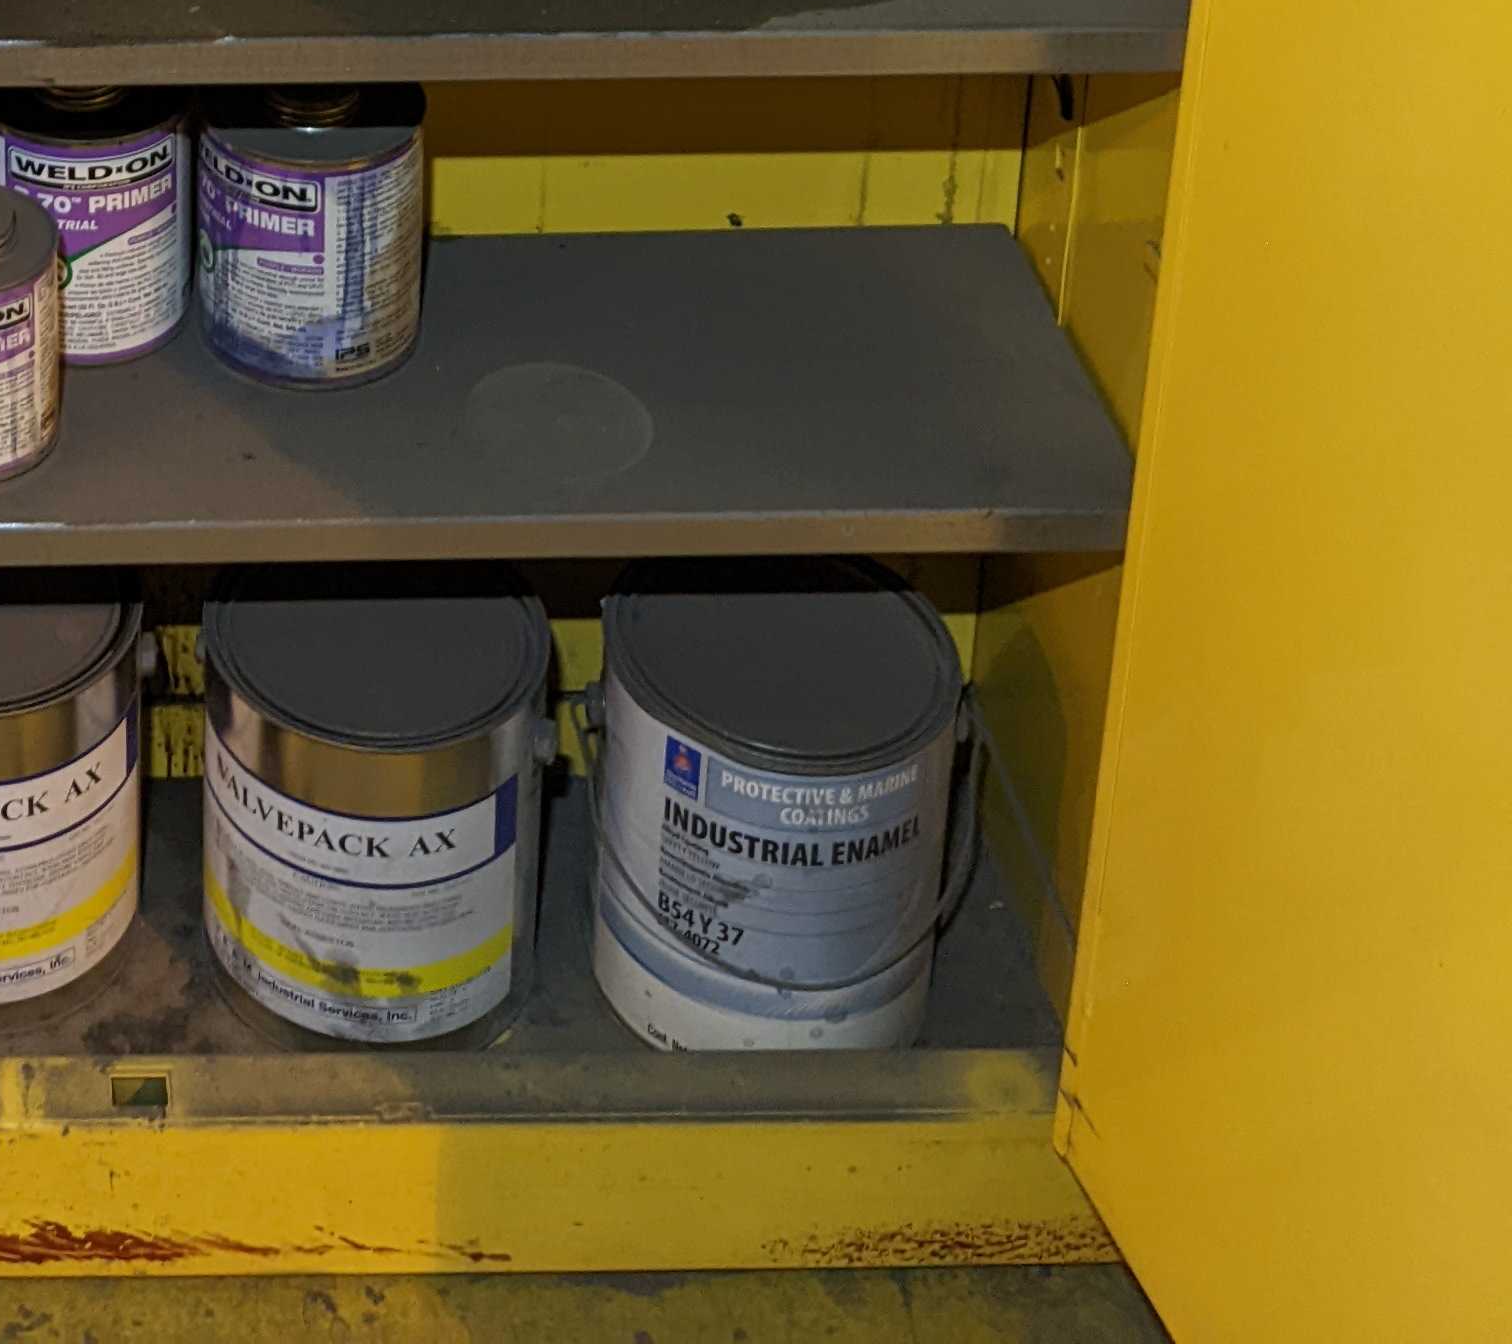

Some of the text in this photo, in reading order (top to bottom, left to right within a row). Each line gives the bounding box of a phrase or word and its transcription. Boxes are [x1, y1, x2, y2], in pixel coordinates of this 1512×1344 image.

[88, 173, 173, 213] PRIMER
[64, 760, 104, 804] AX
[720, 764, 919, 806] PROTECTIVE & MARINE
[216, 752, 457, 859] VALVEPACK AX
[779, 805, 870, 827] COATINGS
[663, 796, 920, 867] INDUSTRIAL ENAMEL
[257, 969, 316, 1009] Industrial
